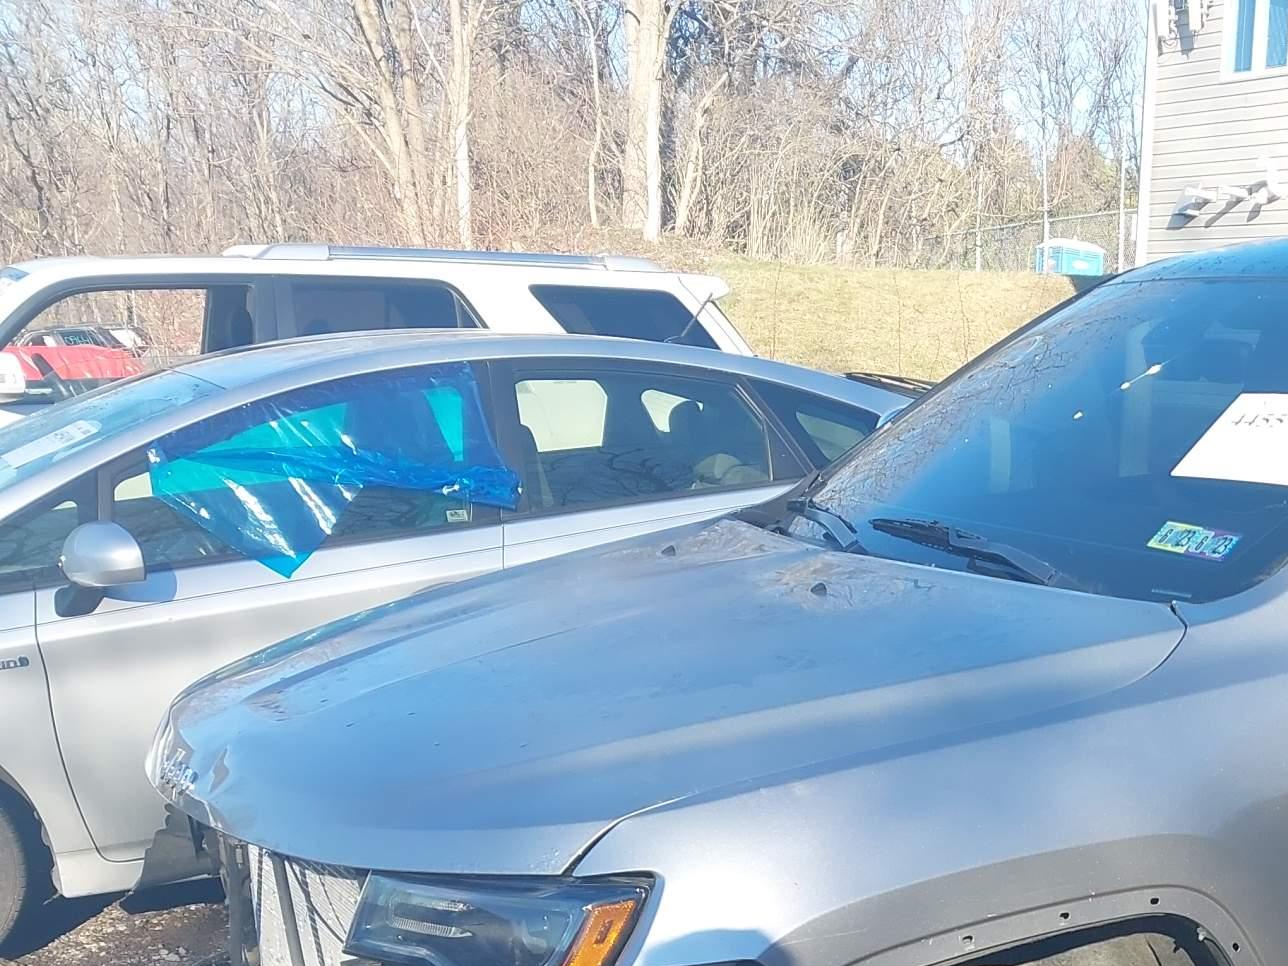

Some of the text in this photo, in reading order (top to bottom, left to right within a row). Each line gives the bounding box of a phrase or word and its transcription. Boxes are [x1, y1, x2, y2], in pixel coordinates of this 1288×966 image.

[1158, 528, 1197, 547] 6 23
[1195, 535, 1234, 555] 6 23
